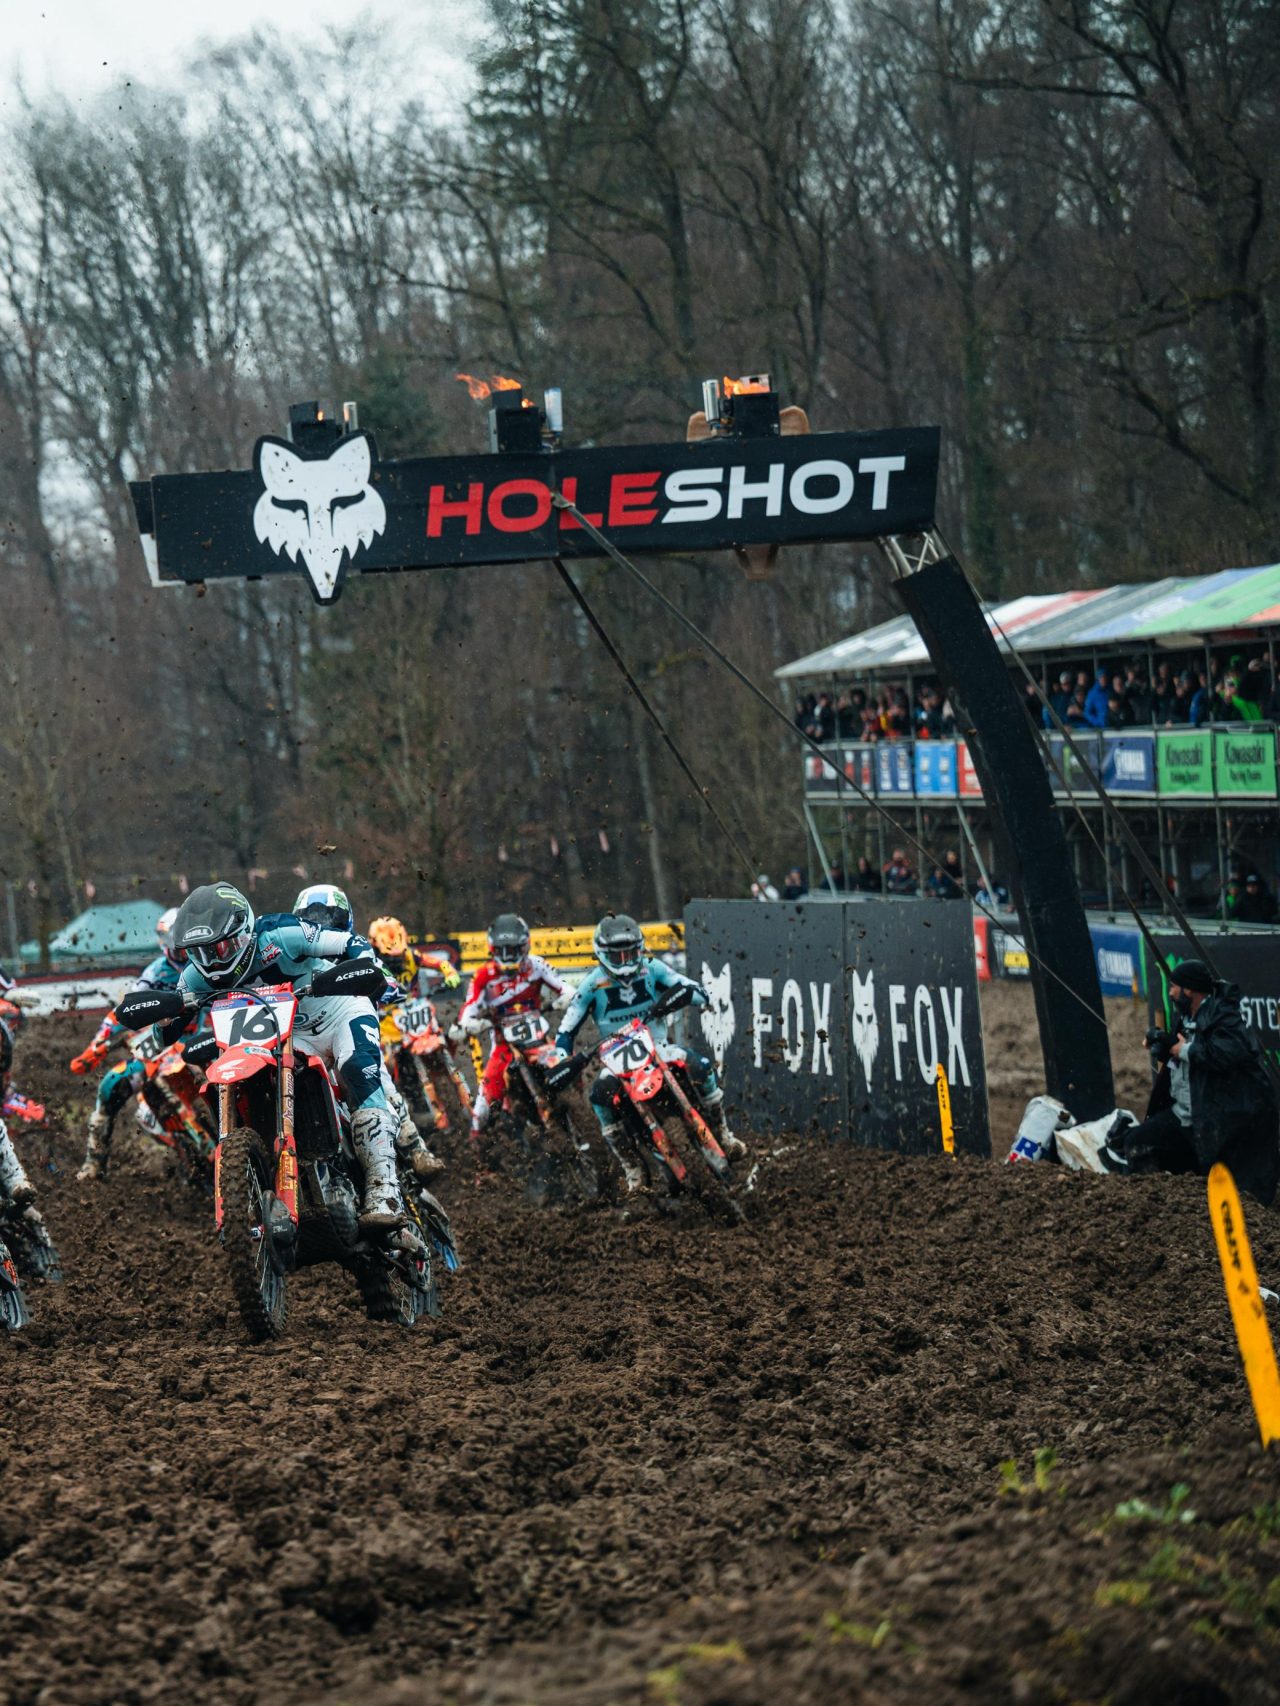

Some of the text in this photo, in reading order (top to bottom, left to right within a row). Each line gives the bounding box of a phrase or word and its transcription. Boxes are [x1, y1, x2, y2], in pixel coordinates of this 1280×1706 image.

[426, 455, 906, 538] HOLESHOT
[185, 928, 210, 939] BELL
[335, 968, 375, 982] ACERBIS
[122, 999, 161, 1013] ACERBIS
[228, 1006, 279, 1047] 16
[511, 1016, 544, 1043] 91
[751, 977, 833, 1076] FOX
[889, 983, 971, 1087] FOX
[612, 1039, 649, 1074] 70
